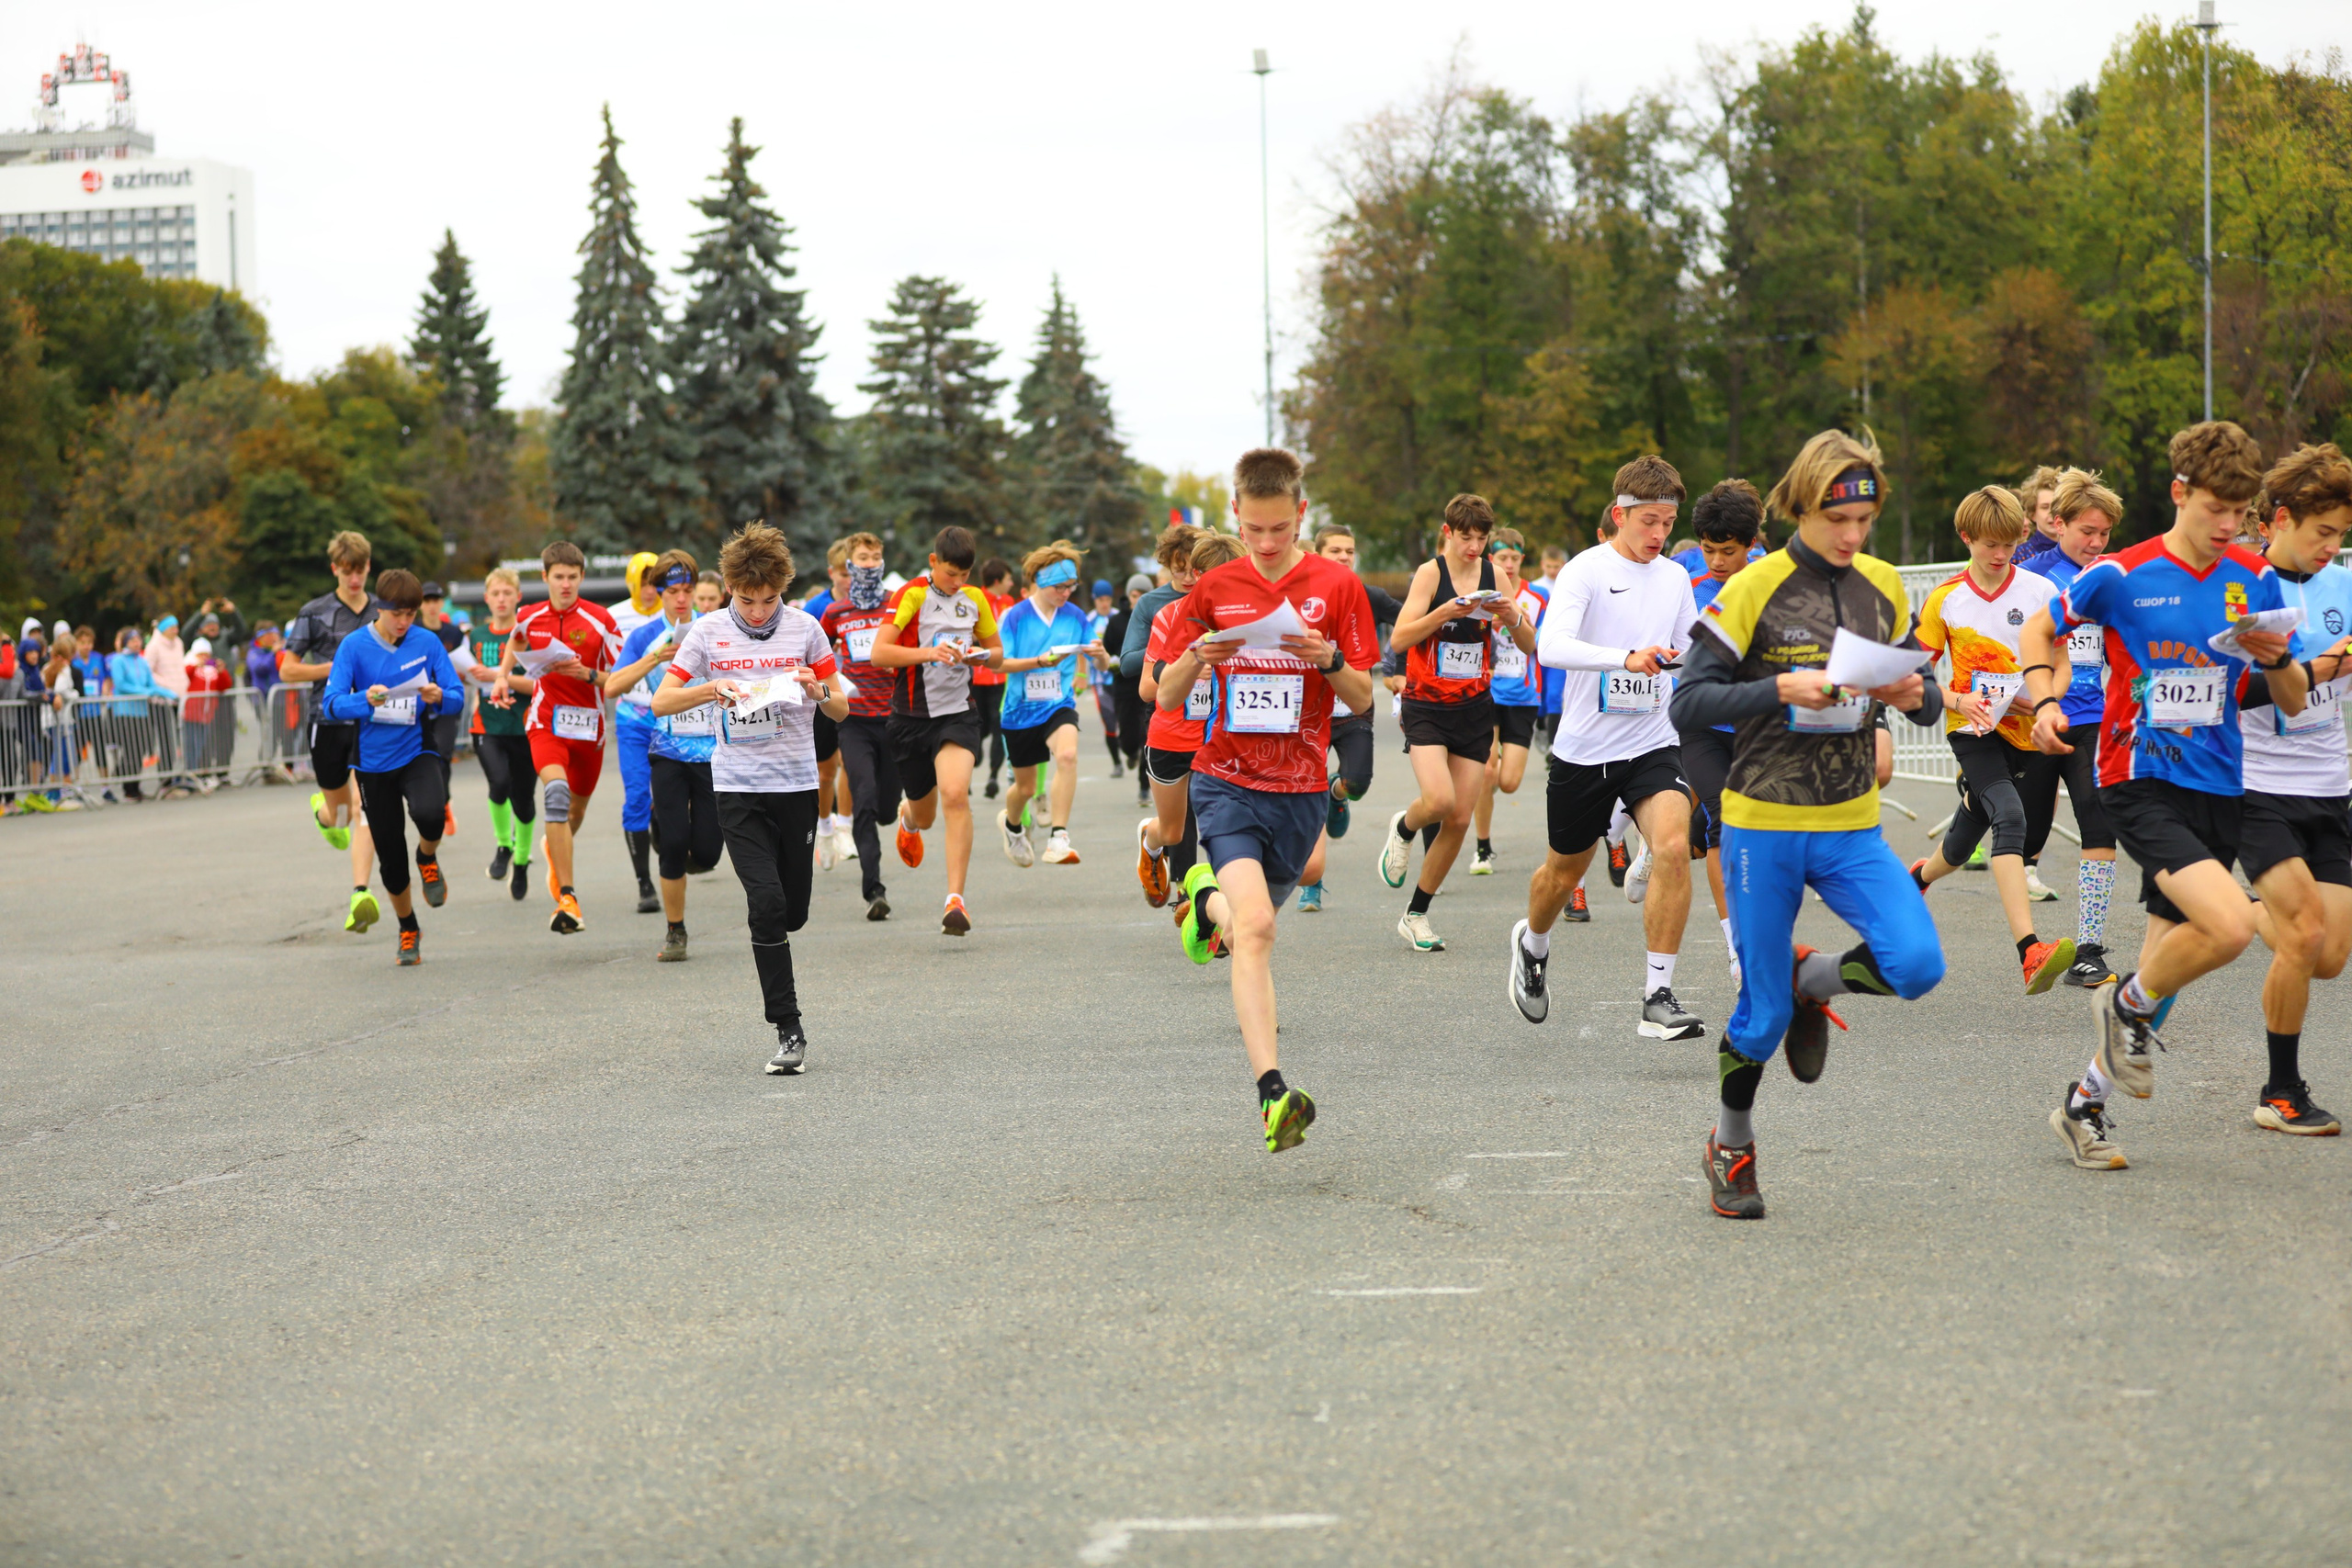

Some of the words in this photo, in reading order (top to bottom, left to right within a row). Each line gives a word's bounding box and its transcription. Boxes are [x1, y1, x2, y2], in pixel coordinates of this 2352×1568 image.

[112, 167, 192, 189] azimut
[2133, 597, 2166, 607] СШОР
[2168, 595, 2181, 605] 18
[837, 619, 866, 634] NORD
[2069, 636, 2100, 649] 357.1
[1446, 649, 1479, 664] 347.1
[710, 660, 753, 671] NORD
[759, 658, 802, 668] WEST
[1028, 680, 1056, 691] 331.1
[1610, 678, 1652, 695] 330.1
[1236, 691, 1291, 709] 325.1
[2154, 683, 2213, 704] 302.1
[558, 713, 591, 727] 322.1
[673, 712, 706, 724] 305.1
